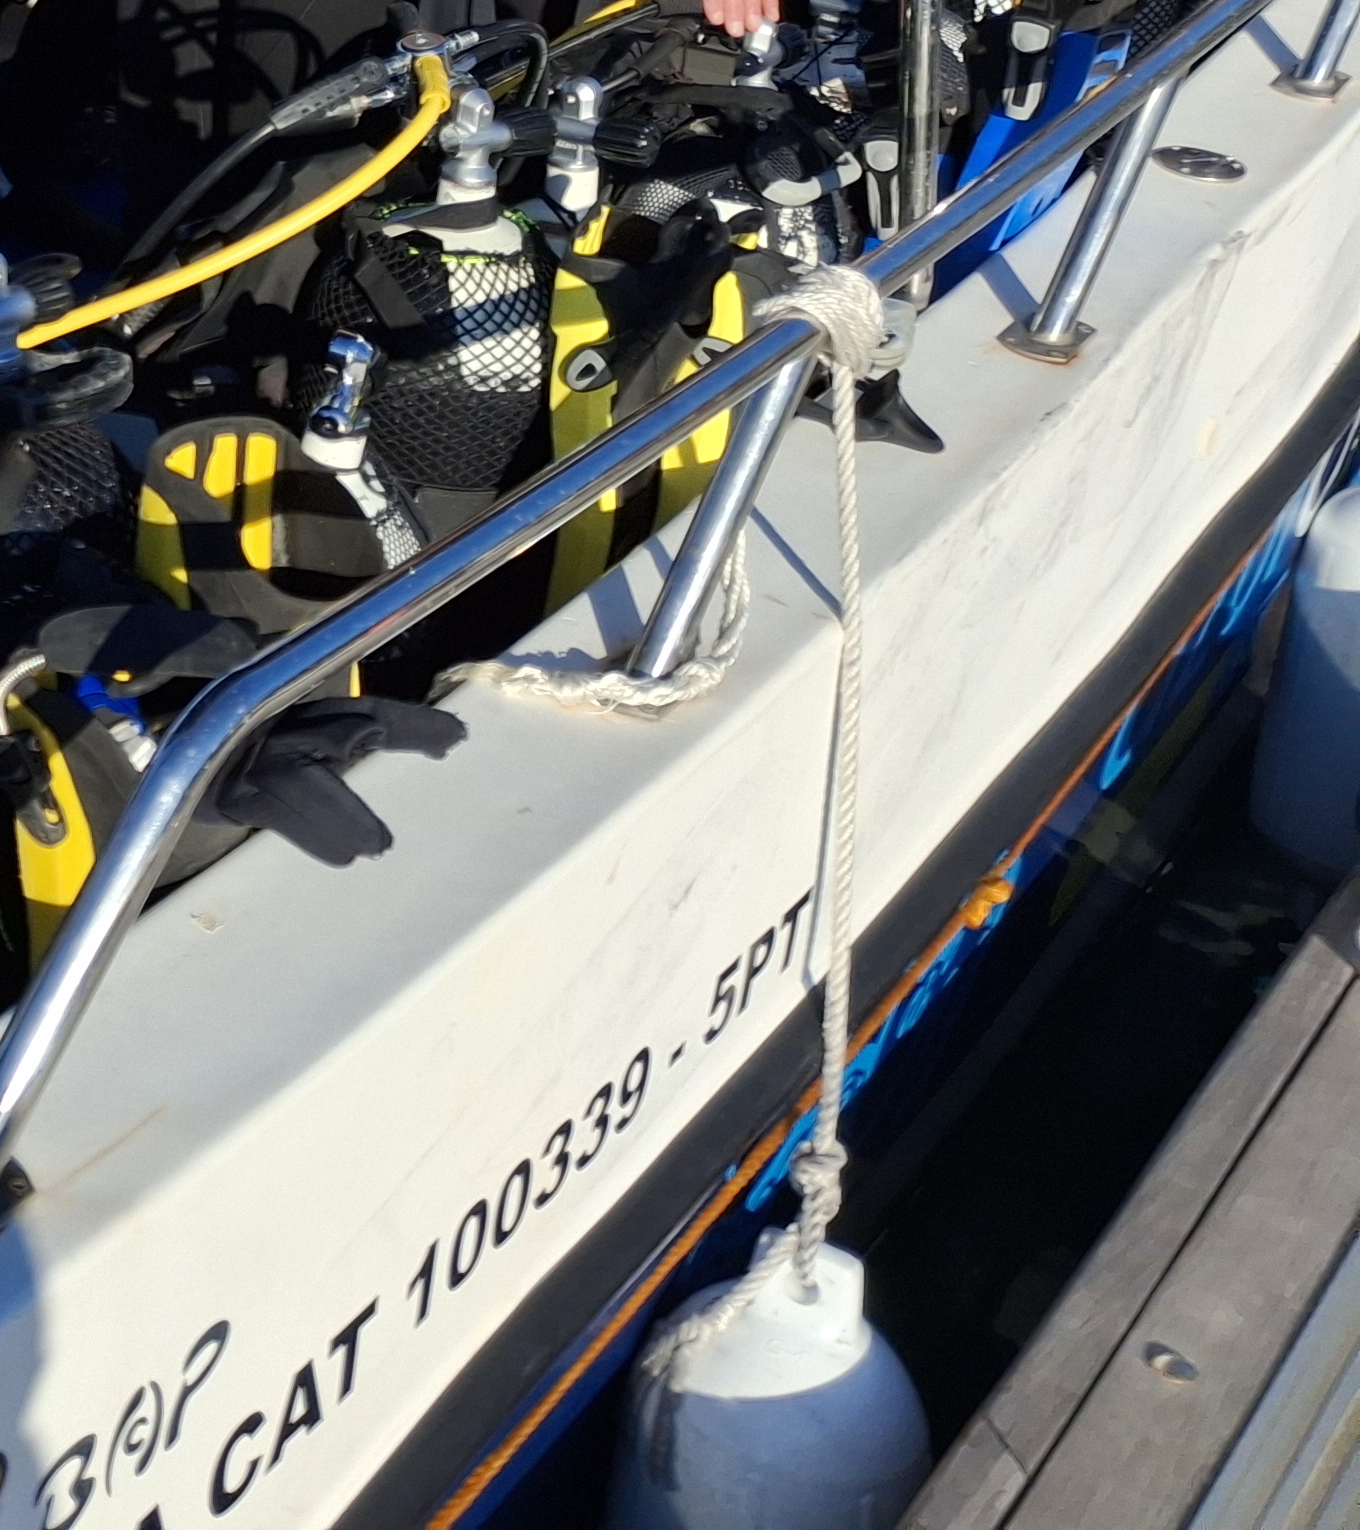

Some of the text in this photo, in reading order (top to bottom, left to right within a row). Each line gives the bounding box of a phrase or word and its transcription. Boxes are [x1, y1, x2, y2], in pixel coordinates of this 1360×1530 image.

[208, 1295, 379, 1518] CAT
[406, 1046, 651, 1328] 100339
[703, 889, 812, 1045] 5PT
